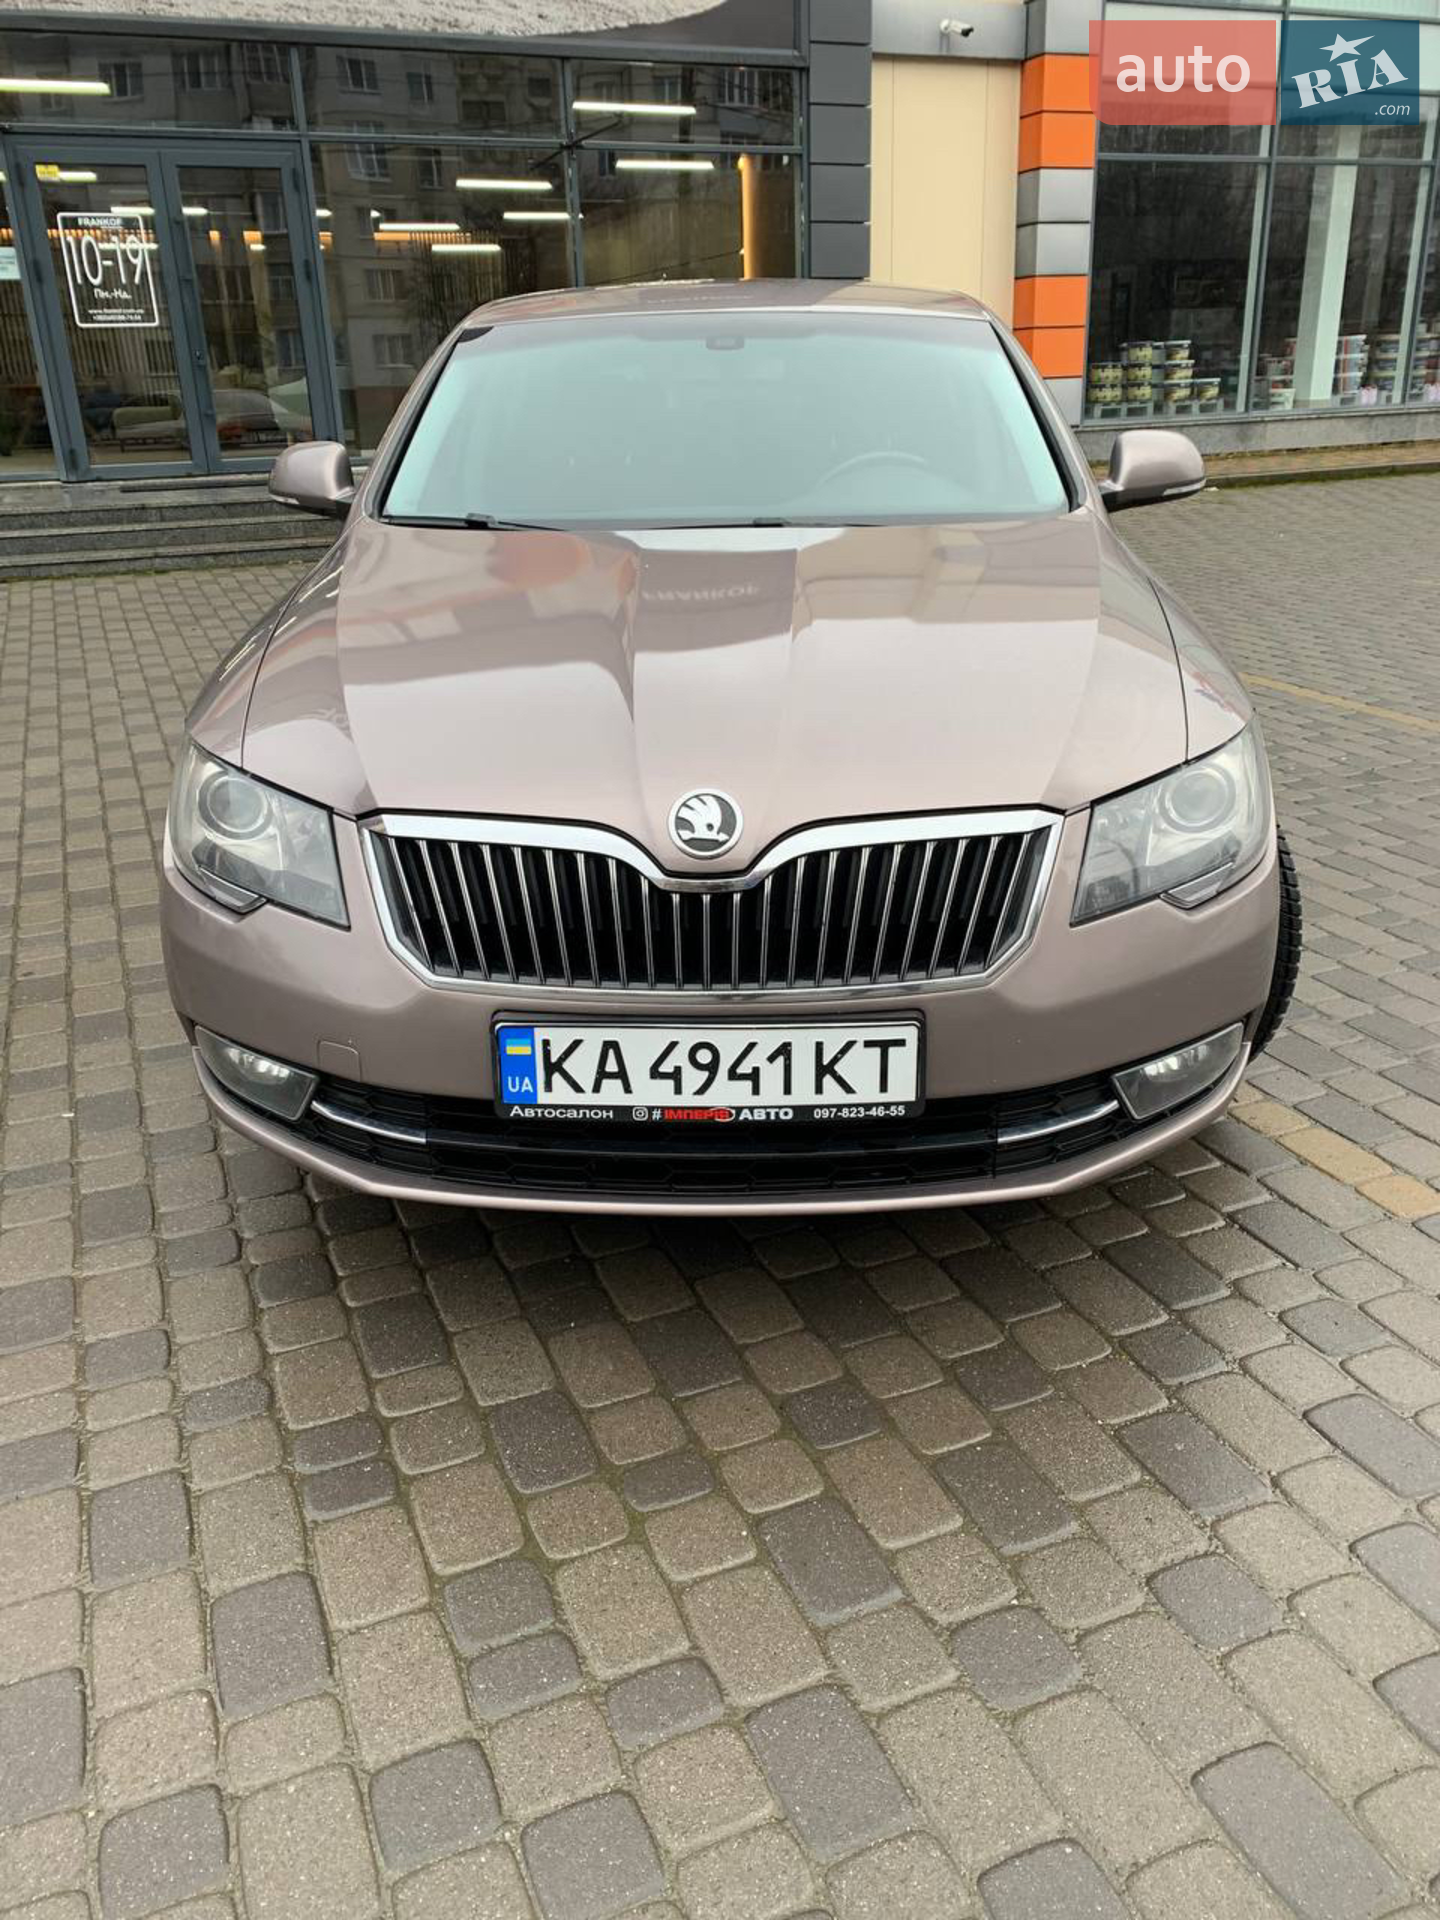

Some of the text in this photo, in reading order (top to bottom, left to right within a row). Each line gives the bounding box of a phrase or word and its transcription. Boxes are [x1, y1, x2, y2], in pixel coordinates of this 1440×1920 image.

[66, 235, 143, 285] 10-19
[541, 1038, 907, 1096] KA 4941 KT
[507, 1076, 534, 1093] UA
[509, 1105, 614, 1120] Автосалон
[738, 1107, 794, 1120] АВТО
[813, 1105, 906, 1119] 097-823-46-55
